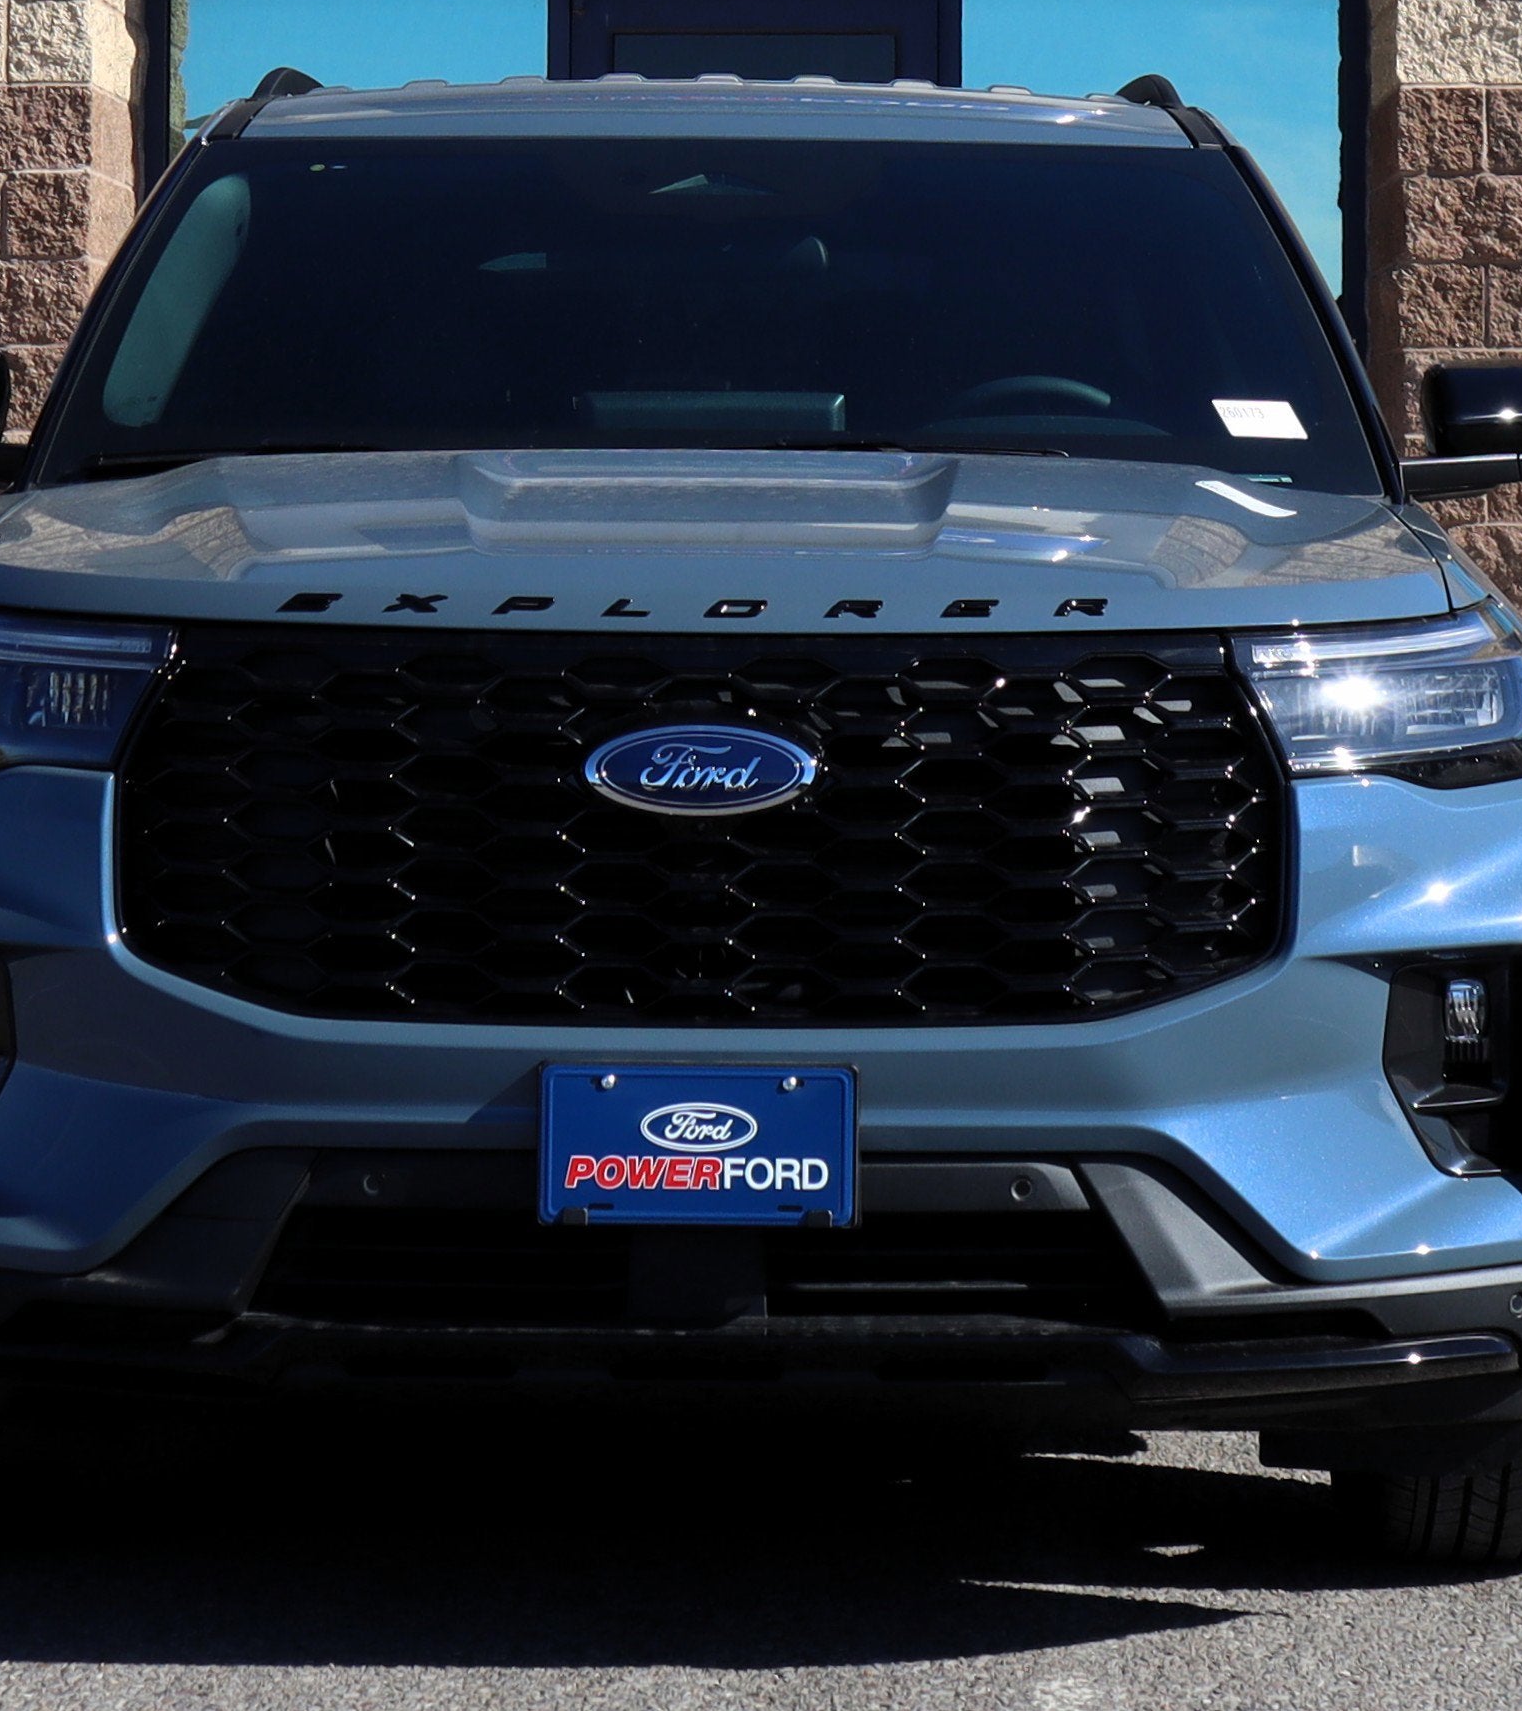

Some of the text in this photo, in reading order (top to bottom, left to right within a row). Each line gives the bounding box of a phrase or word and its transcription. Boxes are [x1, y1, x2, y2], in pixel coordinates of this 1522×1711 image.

[275, 592, 1109, 619] EXPLORER
[639, 743, 761, 790] Ford
[665, 1111, 732, 1140] Ford
